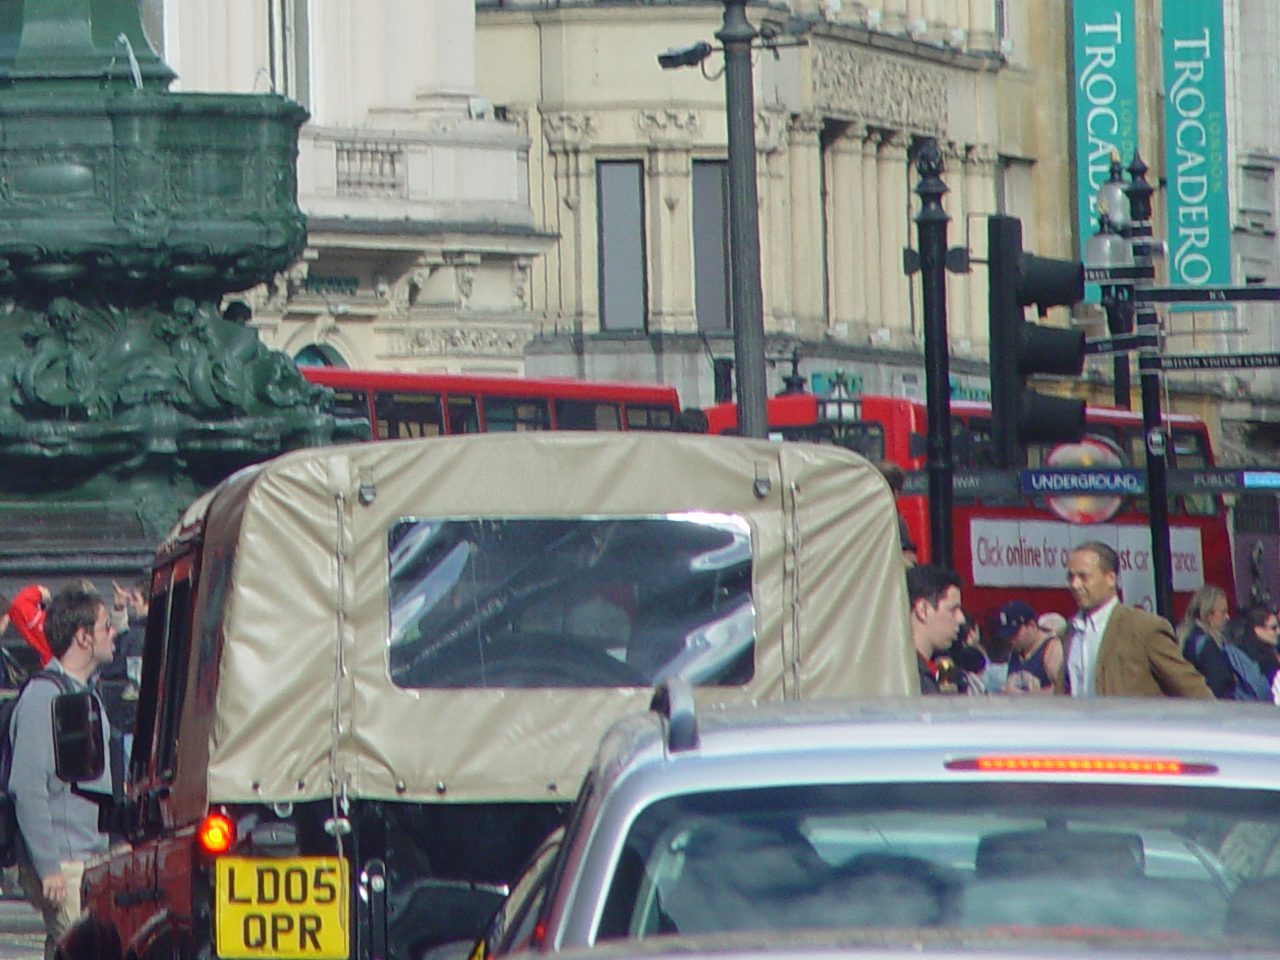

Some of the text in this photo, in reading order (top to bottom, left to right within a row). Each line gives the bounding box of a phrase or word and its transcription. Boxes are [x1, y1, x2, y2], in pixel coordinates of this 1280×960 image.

[1169, 27, 1213, 285] TROCADERO
[1031, 472, 1138, 491] UNDERGROUND
[977, 536, 1004, 568] Click
[1006, 537, 1042, 568] online
[1042, 537, 1059, 568] for
[1120, 548, 1133, 571] st
[1134, 550, 1150, 571] car
[227, 865, 337, 906] LD05
[242, 912, 323, 952] OPR
